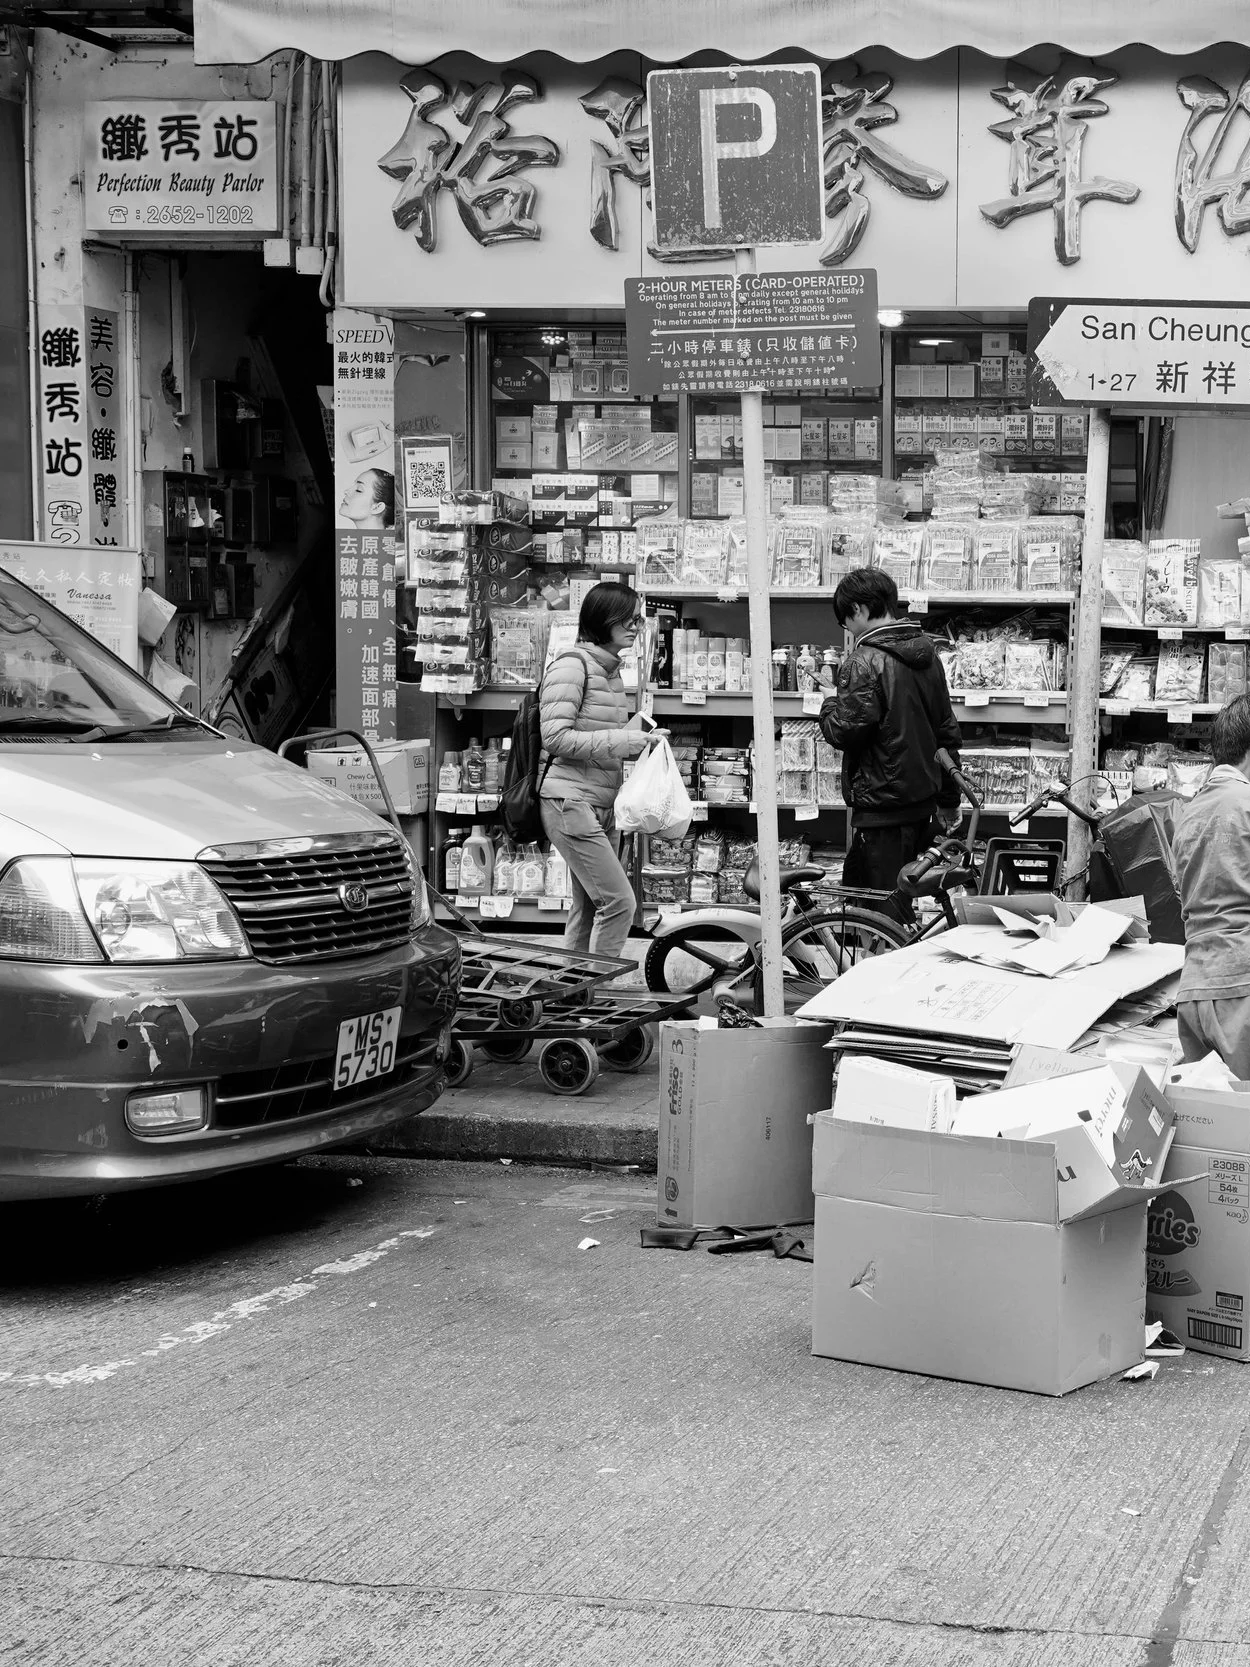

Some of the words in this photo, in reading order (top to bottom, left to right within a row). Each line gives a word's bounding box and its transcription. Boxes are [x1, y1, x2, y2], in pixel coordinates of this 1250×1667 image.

[102, 114, 258, 162] 纖秀站
[699, 87, 777, 229] P
[97, 173, 162, 196] Perfection
[168, 173, 215, 196] Beauty
[222, 172, 264, 193] Parlor
[147, 205, 253, 224] 2652-1202
[638, 281, 687, 294] 2-HOUR
[691, 280, 742, 292] METERS
[745, 275, 865, 291] (CARD-OPERATED)
[639, 294, 678, 302] Operating
[752, 290, 769, 298] daily
[772, 289, 798, 298] except
[801, 288, 829, 297] general
[832, 287, 864, 295] holidays
[669, 301, 697, 310] general
[700, 300, 731, 309] holidays
[743, 306, 771, 314] defects
[669, 318, 690, 326] meter
[693, 317, 720, 325] number
[723, 316, 752, 324] marked
[780, 315, 797, 323] post
[833, 313, 852, 321] given
[1081, 315, 1136, 340] San
[336, 329, 384, 344] SPEED
[338, 367, 386, 380] 無針埋線
[42, 327, 83, 477] 纖秀站
[67, 588, 112, 600] Vanessa
[340, 536, 358, 634] 去皺嫩膚。
[354, 1014, 383, 1050] MS
[672, 1039, 683, 1054] 3
[338, 1046, 393, 1088] 5730
[669, 1066, 679, 1115] Friso
[1213, 1160, 1246, 1172] 23088
